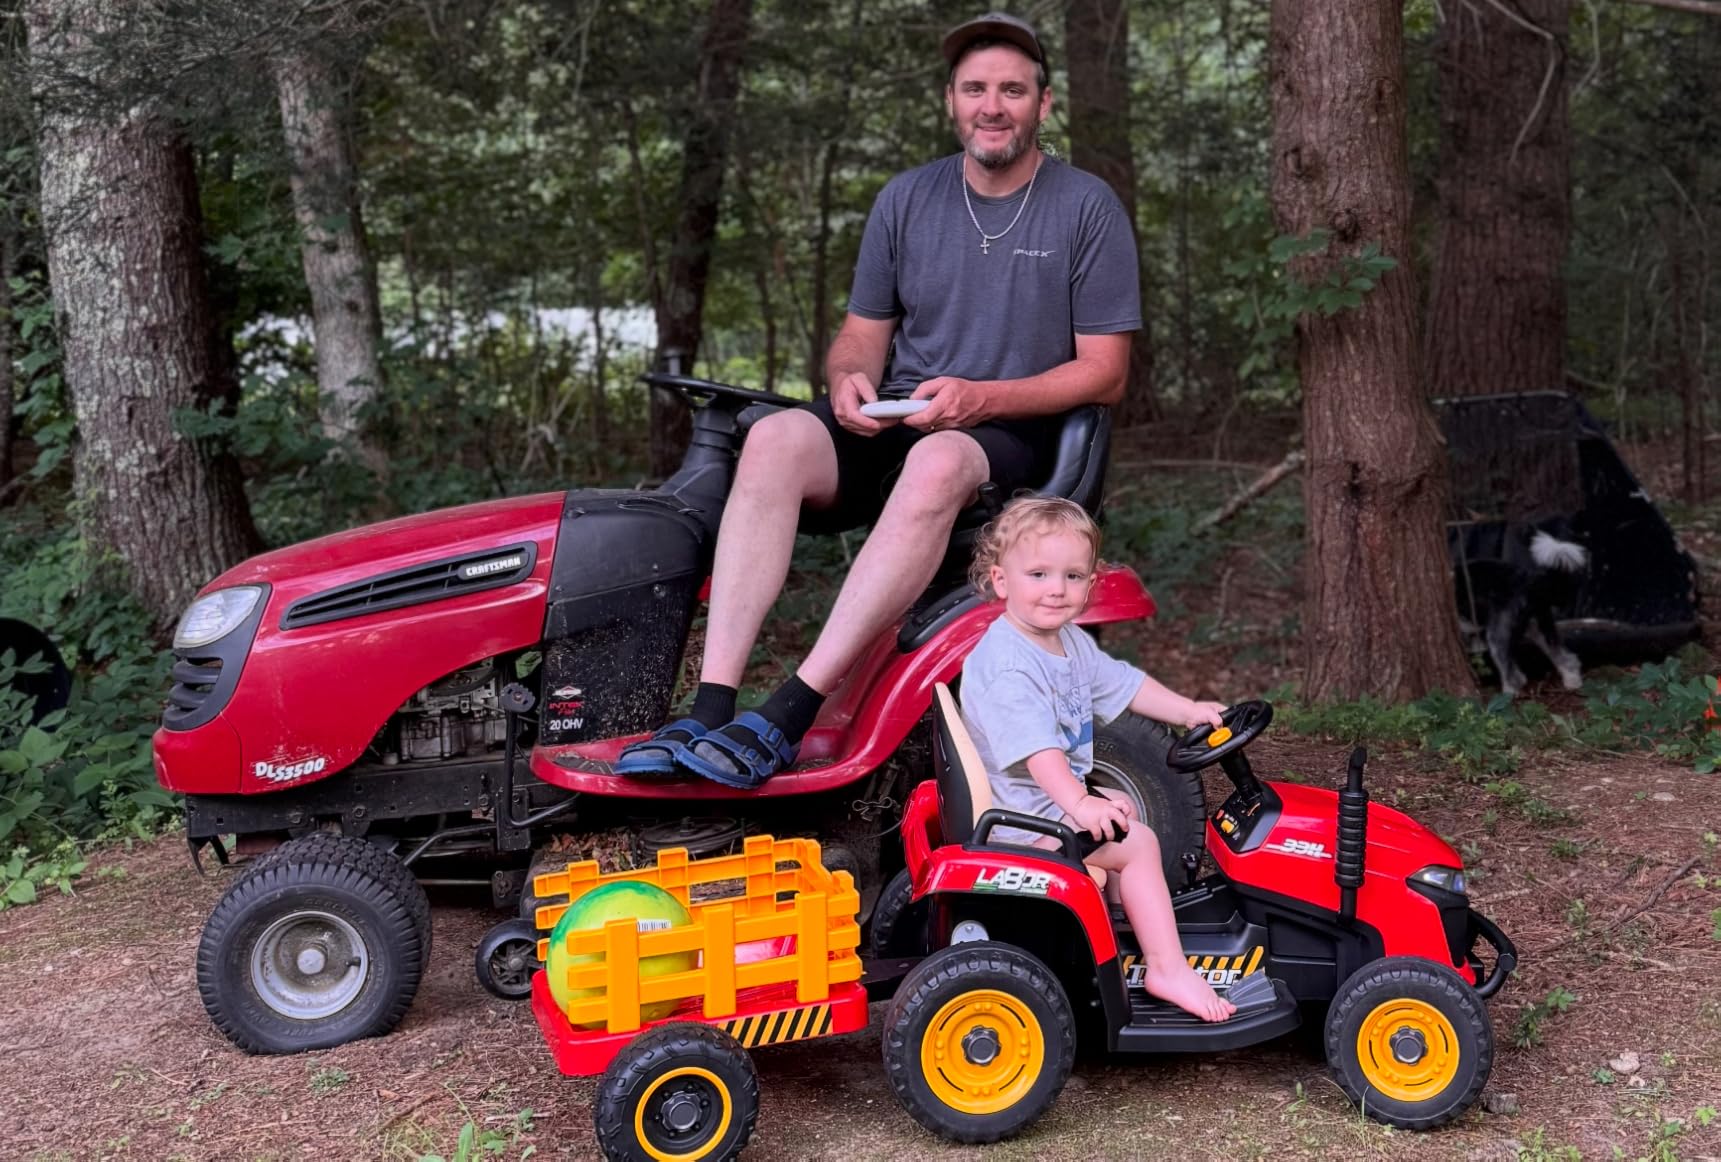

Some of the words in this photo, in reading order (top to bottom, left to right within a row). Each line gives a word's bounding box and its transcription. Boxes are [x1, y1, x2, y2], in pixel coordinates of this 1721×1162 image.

[466, 556, 521, 576] CRAFTSMAN
[549, 720, 561, 731] 20
[562, 718, 583, 730] OHV
[255, 757, 325, 782] DLS3500
